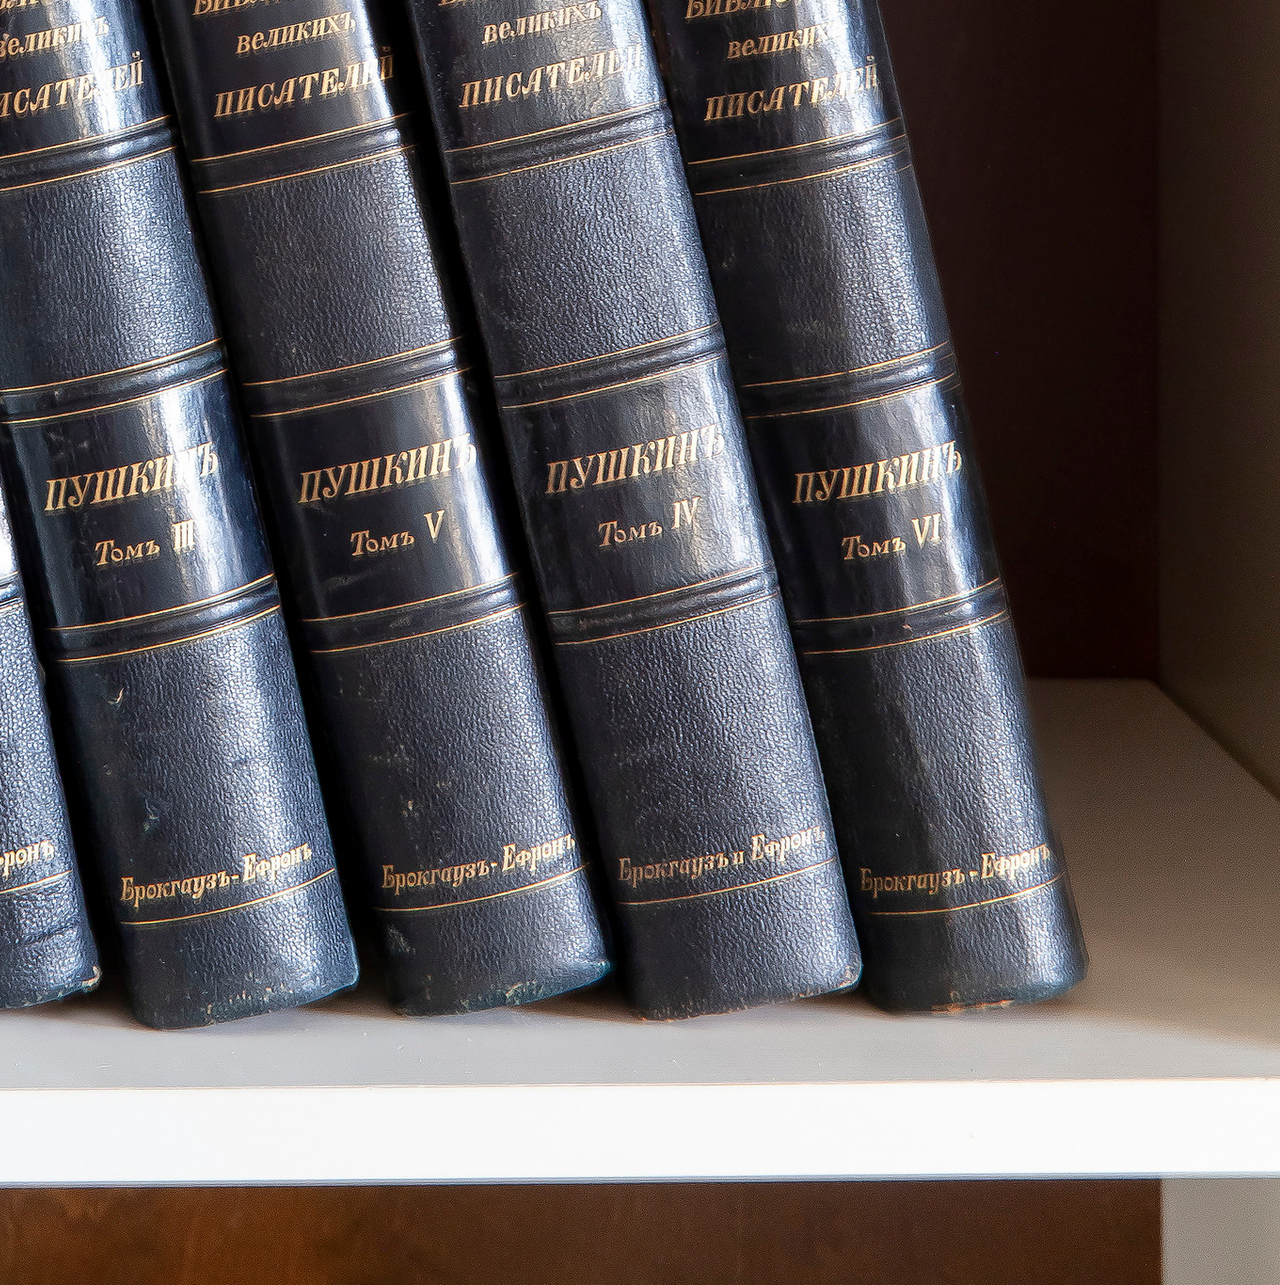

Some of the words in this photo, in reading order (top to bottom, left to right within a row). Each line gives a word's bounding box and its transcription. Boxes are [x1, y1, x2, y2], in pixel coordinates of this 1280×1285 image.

[235, 12, 356, 55] великихъ
[482, 0, 602, 45] великихъ
[727, 22, 842, 59] великих
[214, 46, 394, 118] ПИСАТЕЛЕЙ
[44, 441, 218, 511] ПУШКИЪ
[297, 433, 477, 504] ПУШКИНЪ
[544, 423, 725, 495] ПУШКИНЪ
[792, 440, 962, 504] ПУШКИНЪ
[94, 539, 160, 566] Томъ
[172, 519, 195, 550] III
[350, 530, 415, 556] Томъ
[423, 510, 445, 542] V
[598, 520, 663, 547] Томъ
[671, 496, 702, 530] IV
[841, 534, 906, 561] Томъ
[911, 513, 941, 548] VI
